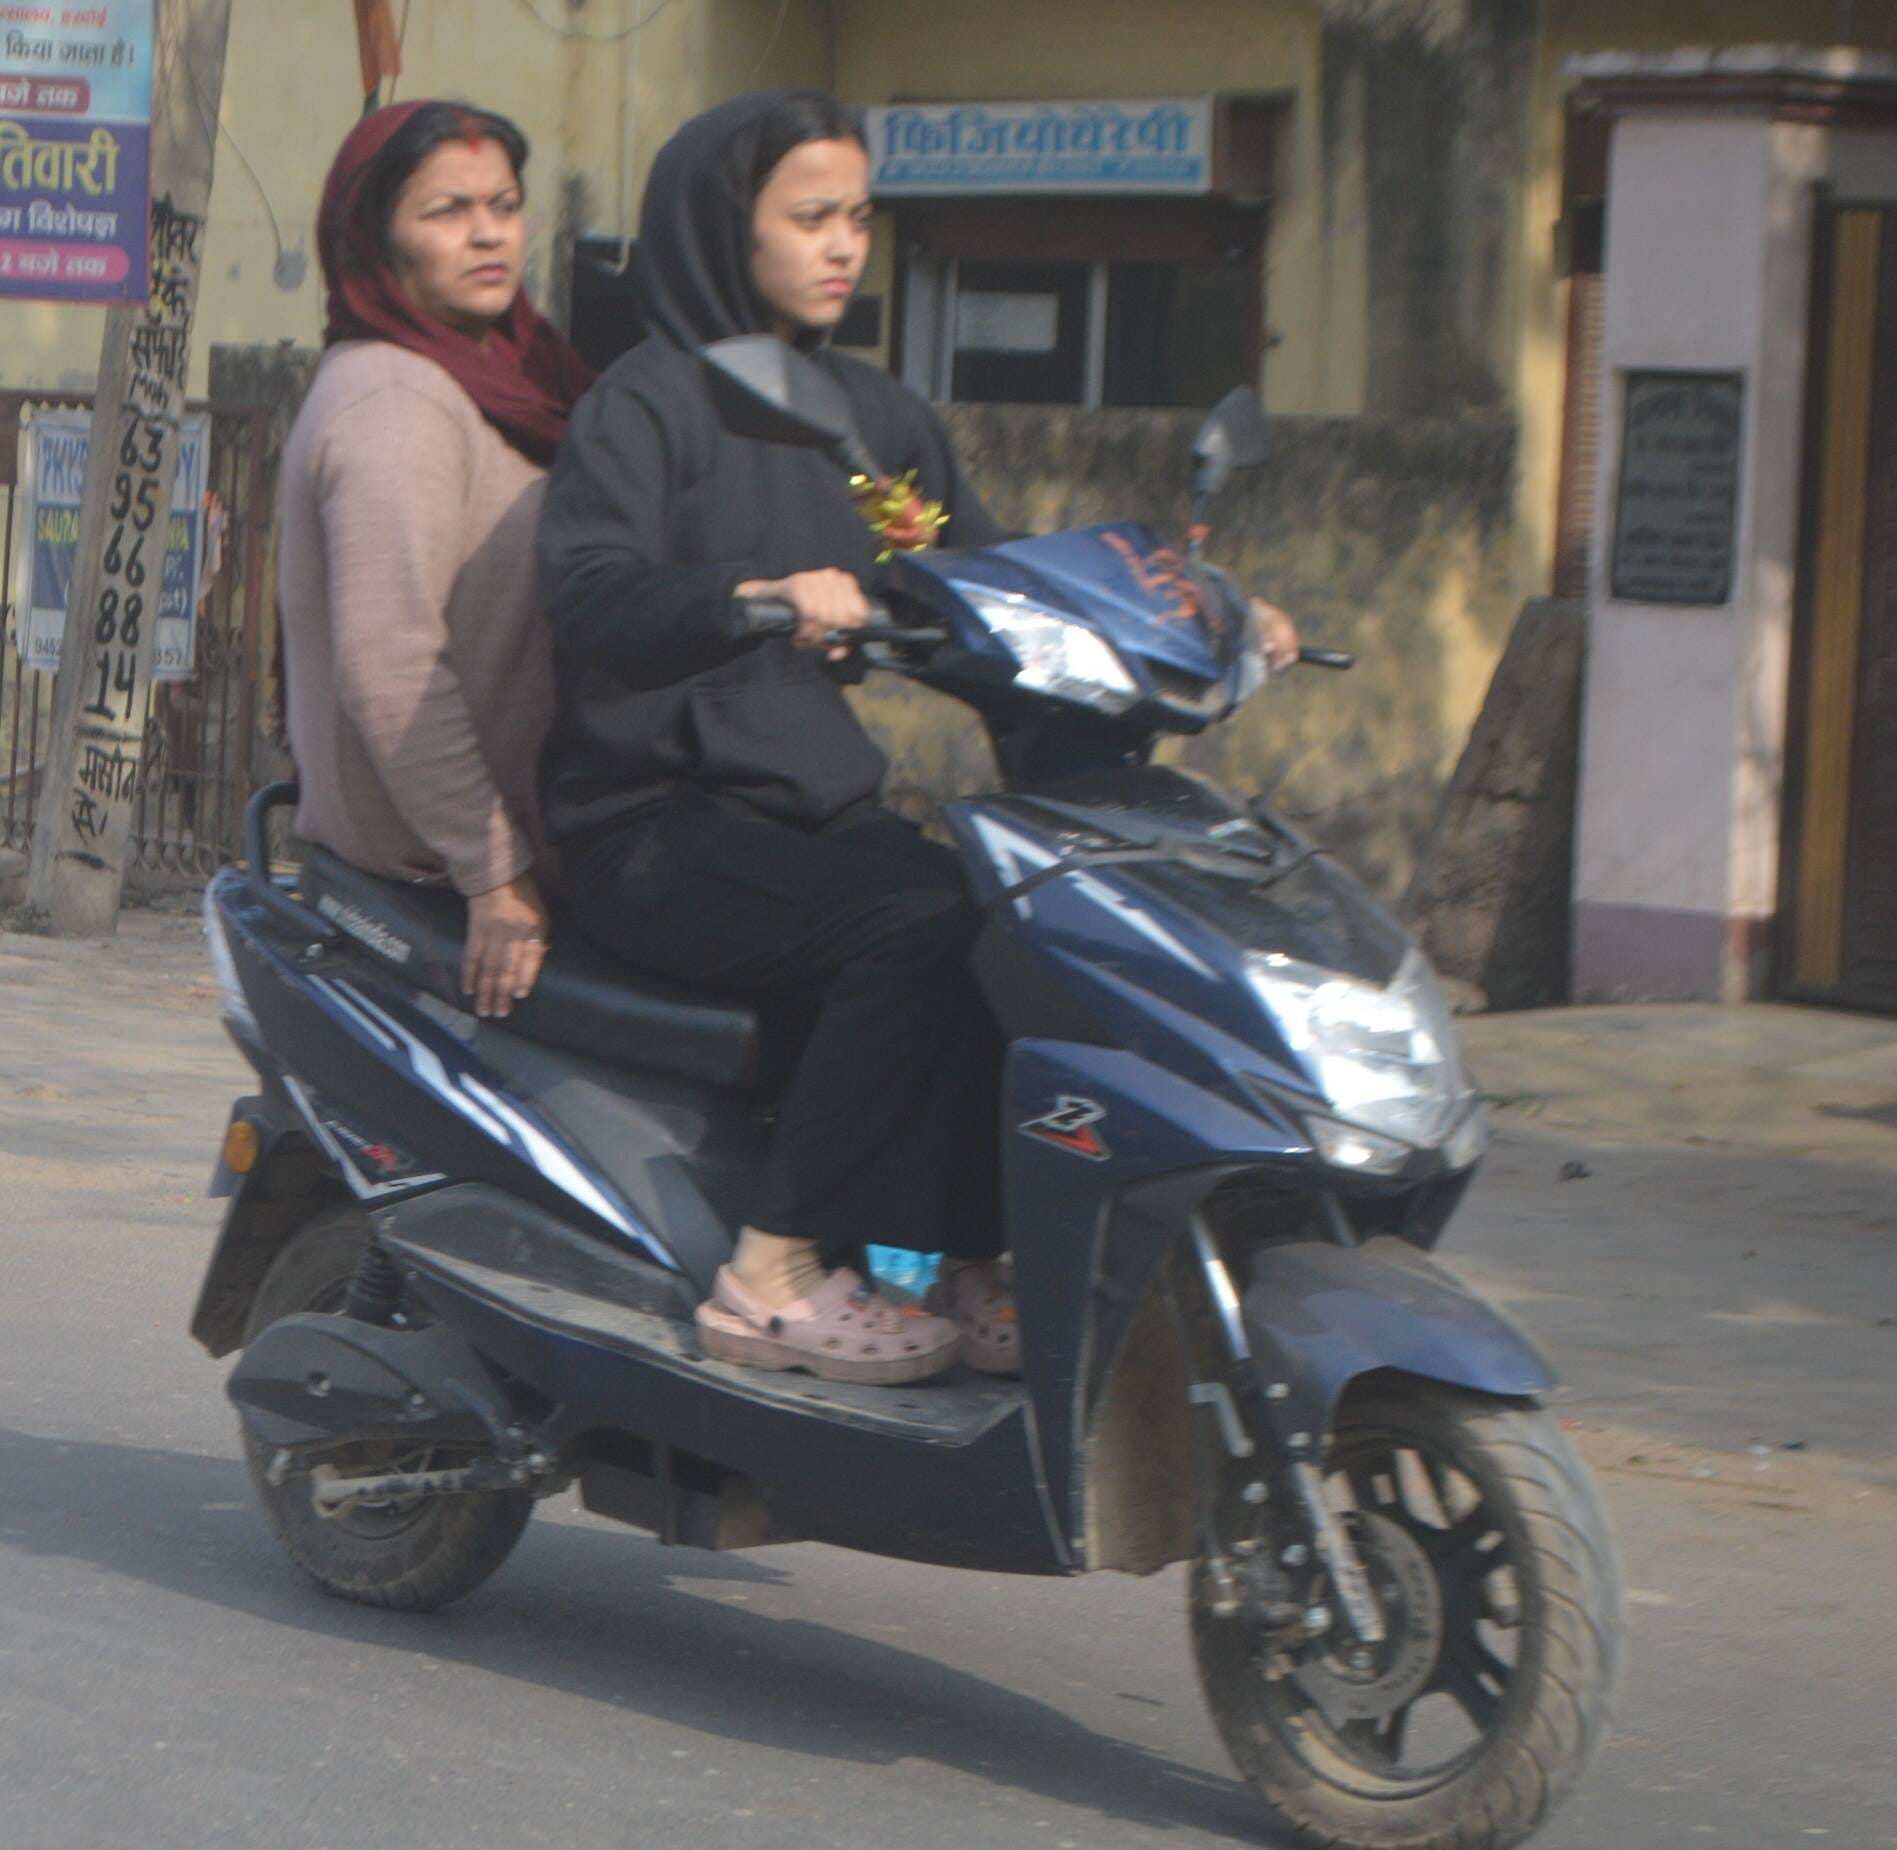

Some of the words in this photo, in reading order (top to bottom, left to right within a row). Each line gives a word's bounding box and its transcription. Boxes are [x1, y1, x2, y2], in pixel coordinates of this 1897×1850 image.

[6, 28, 53, 58] किया
[59, 42, 105, 64] जाता
[37, 84, 80, 108] तक
[65, 254, 108, 277] तक
[120, 414, 163, 472] 63
[110, 471, 160, 532] 95
[103, 520, 145, 587] 66
[95, 588, 143, 647] 88
[84, 648, 137, 723] 14
